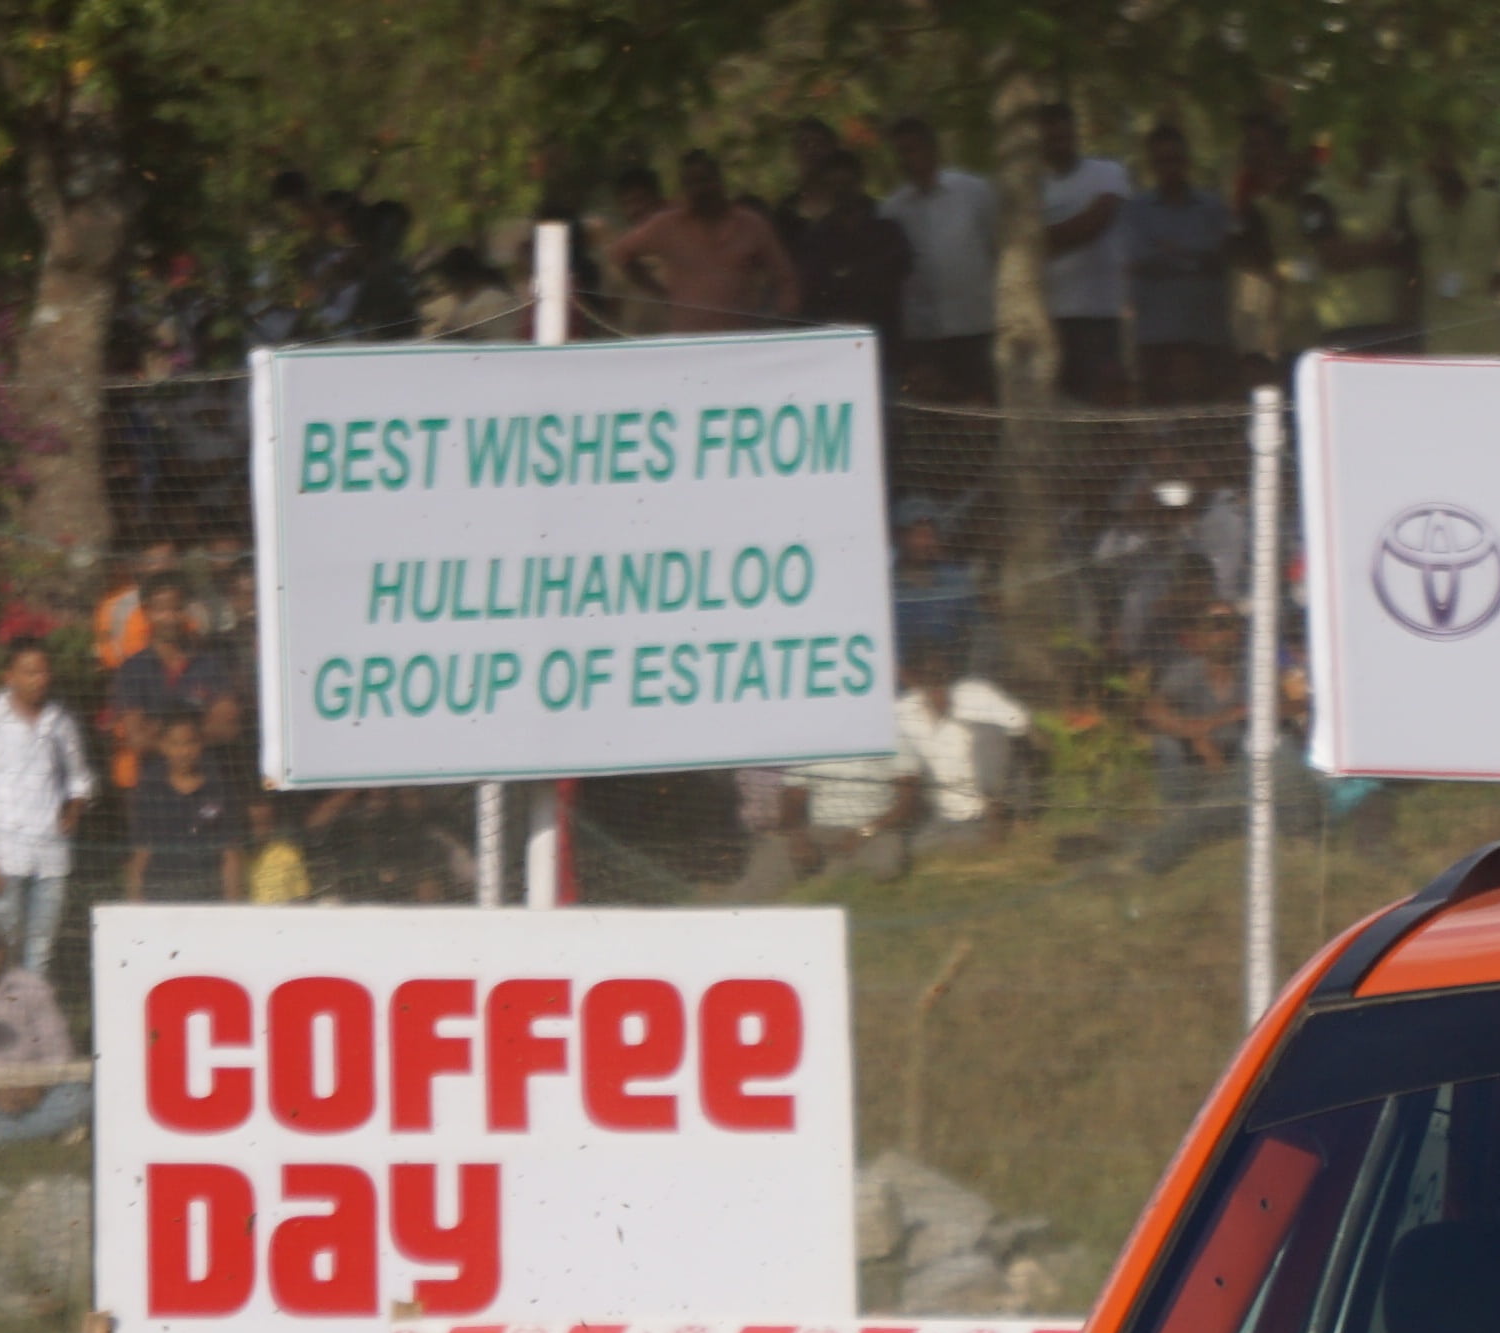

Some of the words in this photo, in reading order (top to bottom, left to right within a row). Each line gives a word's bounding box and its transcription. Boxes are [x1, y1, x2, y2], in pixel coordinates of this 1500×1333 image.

[299, 416, 450, 494] BEST
[466, 409, 677, 488] WISHES
[694, 400, 854, 480] FROM
[368, 541, 816, 624] HULLIHANDLOO
[314, 649, 523, 721] GROUP
[538, 647, 615, 712] OF
[629, 633, 876, 708] ESTATES
